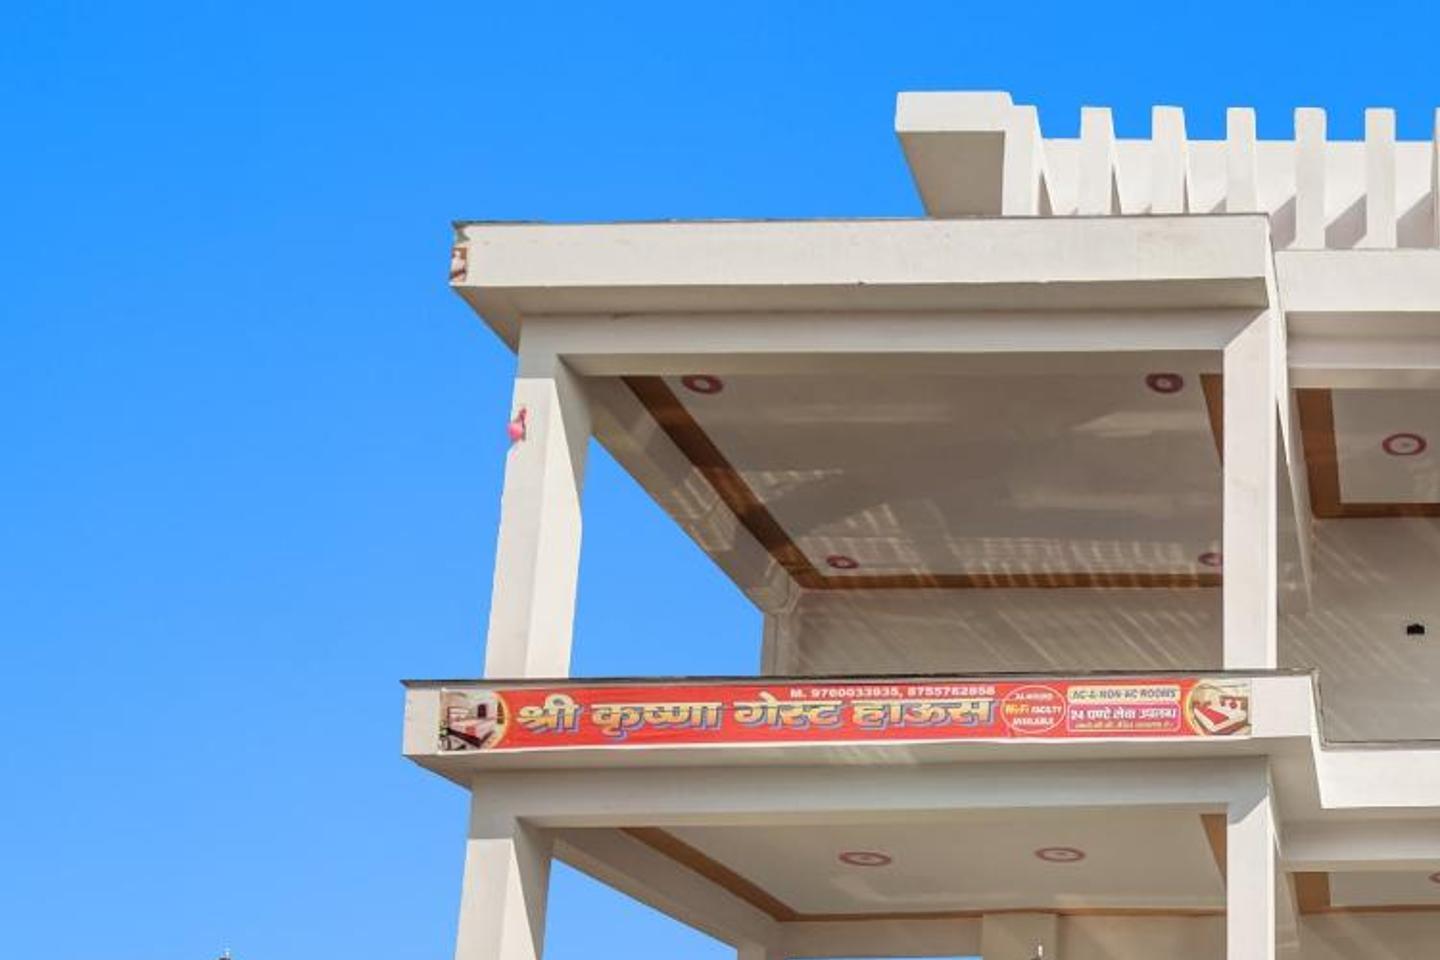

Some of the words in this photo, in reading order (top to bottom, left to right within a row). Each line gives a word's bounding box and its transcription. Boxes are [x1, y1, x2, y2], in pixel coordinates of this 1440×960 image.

[517, 694, 583, 735] श्री
[591, 702, 724, 742] कृष्णा
[734, 691, 844, 731] गेस्ट
[851, 697, 995, 731] हाऊस
